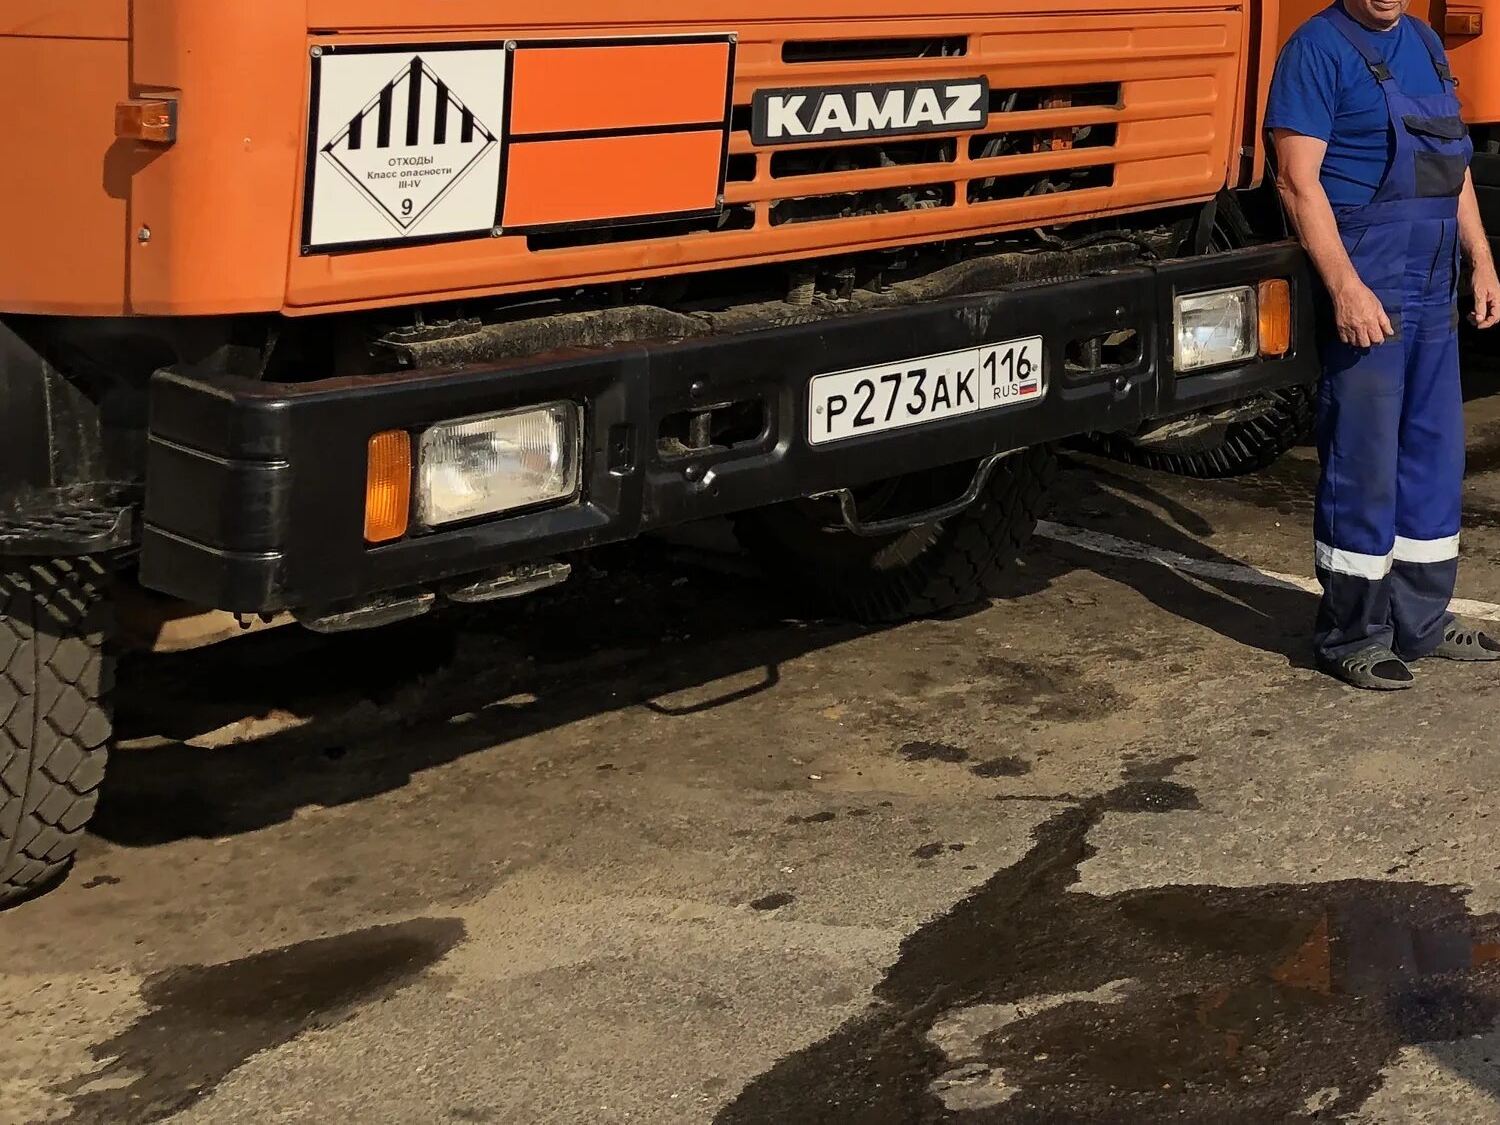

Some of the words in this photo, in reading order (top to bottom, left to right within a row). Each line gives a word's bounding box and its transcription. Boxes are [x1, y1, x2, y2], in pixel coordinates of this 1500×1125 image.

[766, 83, 982, 138] KAMAZ
[388, 156, 434, 166] ОТХОДЫ
[367, 171, 397, 179] Класс
[400, 168, 452, 178] опасности
[398, 180, 421, 189] III-IV
[401, 198, 413, 216] 9
[826, 367, 975, 433] Р273АК
[983, 345, 1032, 382] 116
[993, 383, 1018, 399] RUS
